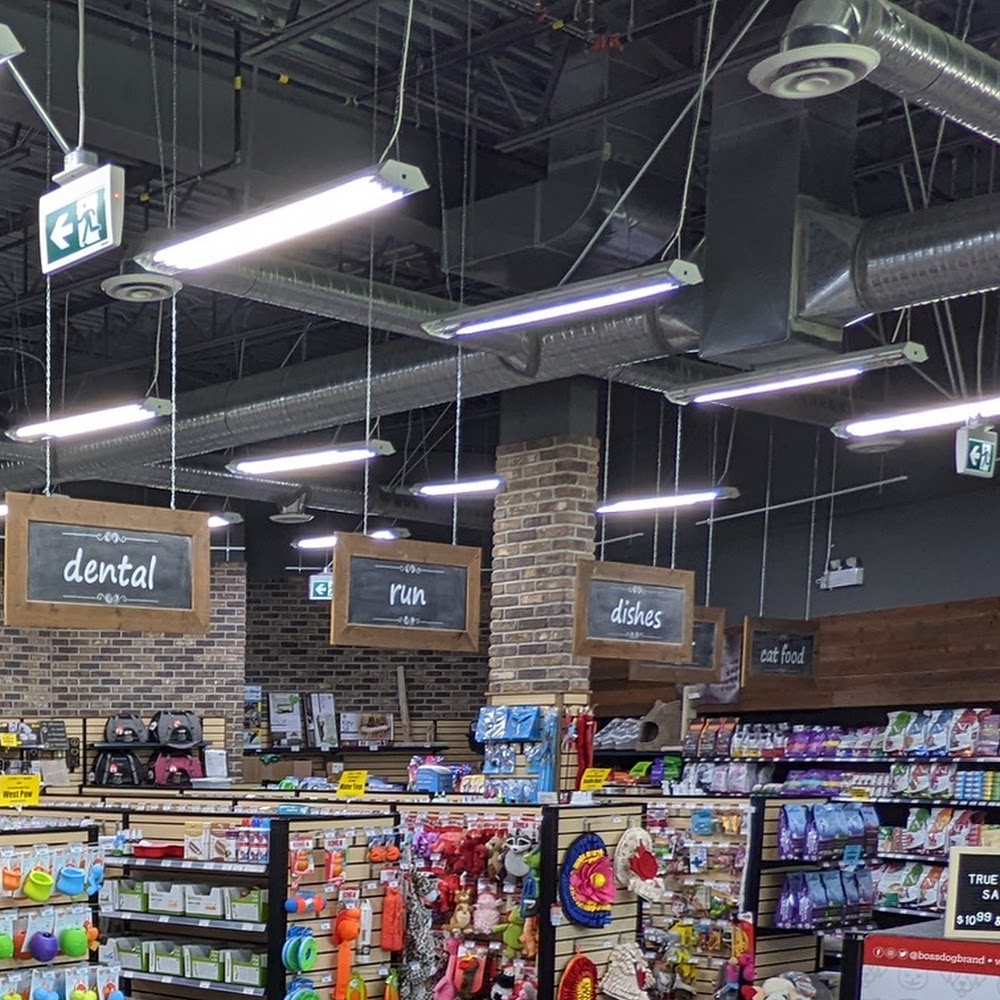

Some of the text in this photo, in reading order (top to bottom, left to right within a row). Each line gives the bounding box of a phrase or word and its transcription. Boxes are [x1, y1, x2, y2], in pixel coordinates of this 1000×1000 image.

[63, 548, 158, 591] dental
[388, 583, 427, 607] run
[610, 598, 662, 630] dishes
[759, 643, 805, 665] cat food
[3, 789, 33, 798] West Paw
[967, 873, 999, 885] TRUE
[909, 950, 986, 966] @bossdogbrand
